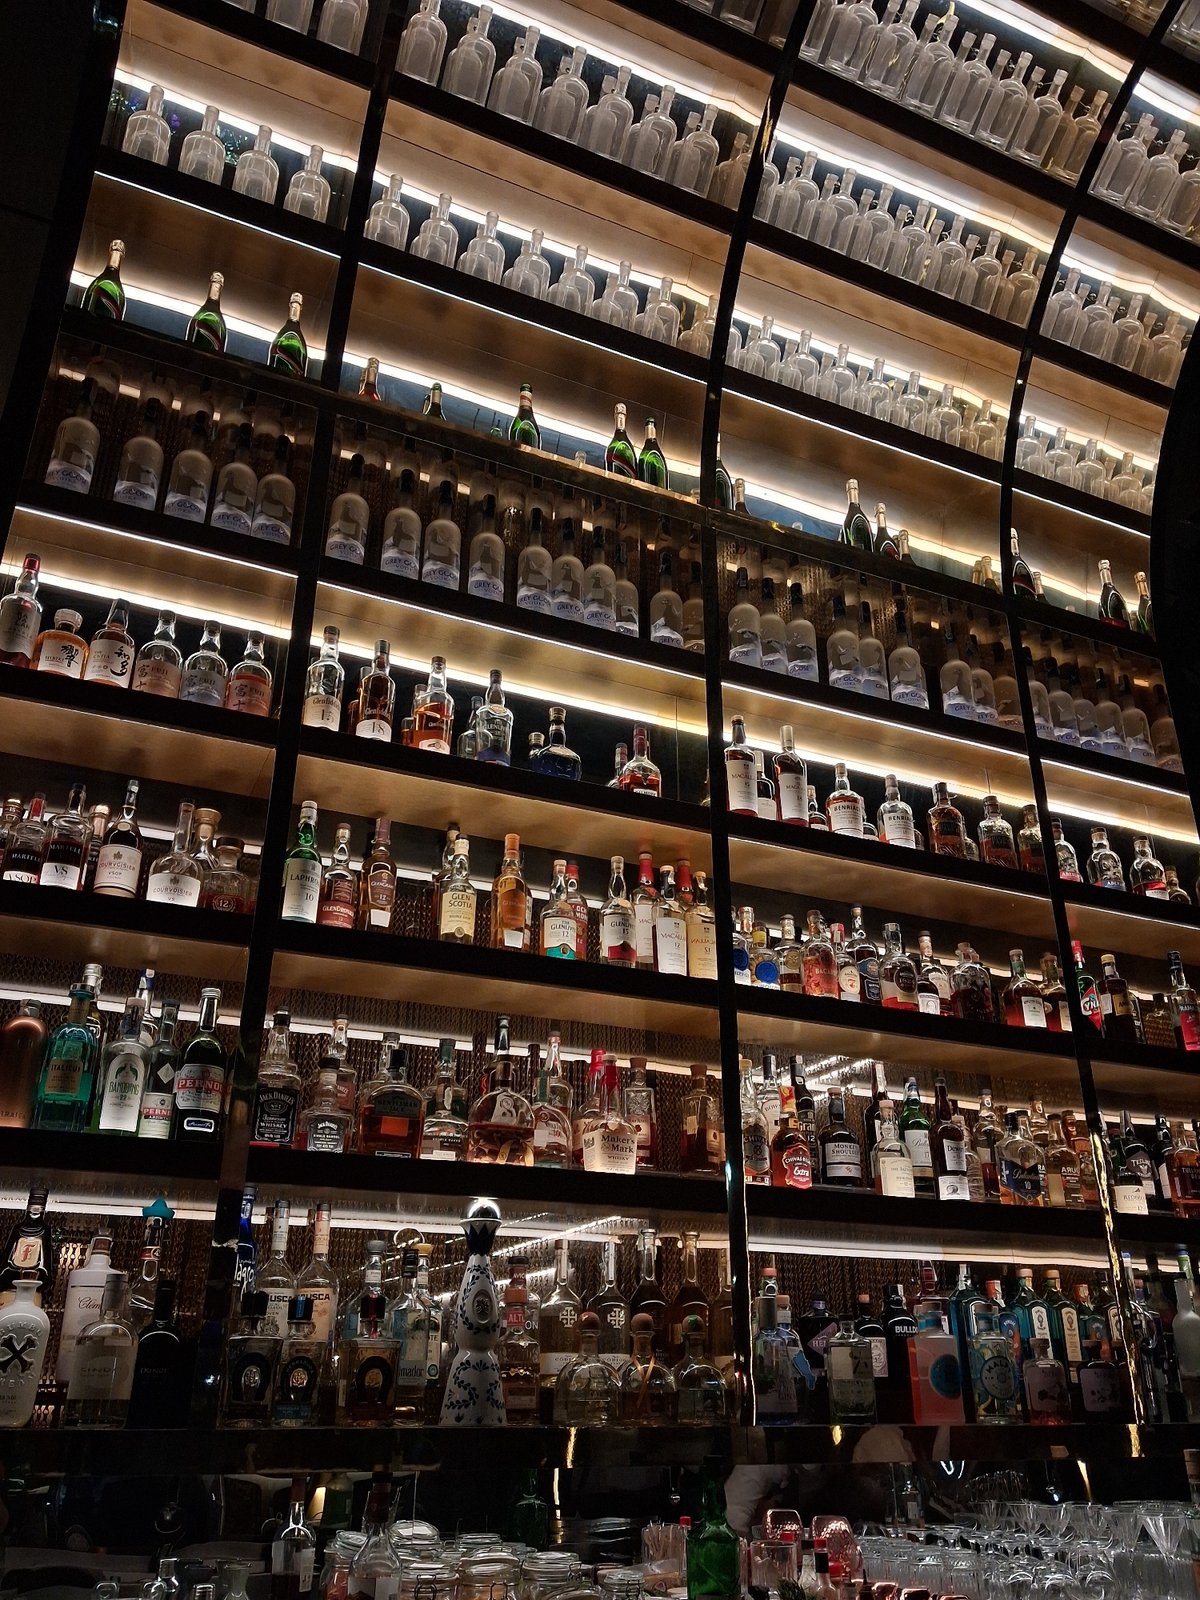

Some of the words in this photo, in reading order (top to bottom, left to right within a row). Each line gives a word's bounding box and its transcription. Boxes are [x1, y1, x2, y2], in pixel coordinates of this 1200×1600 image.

[53, 864, 69, 875] VS
[451, 892, 472, 901] GLEN
[219, 899, 229, 908] 12
[448, 900, 473, 909] SCOTIA
[259, 1121, 288, 1130] WHISKEY
[600, 1134, 636, 1146] Maker's
[611, 1144, 635, 1154] Mark
